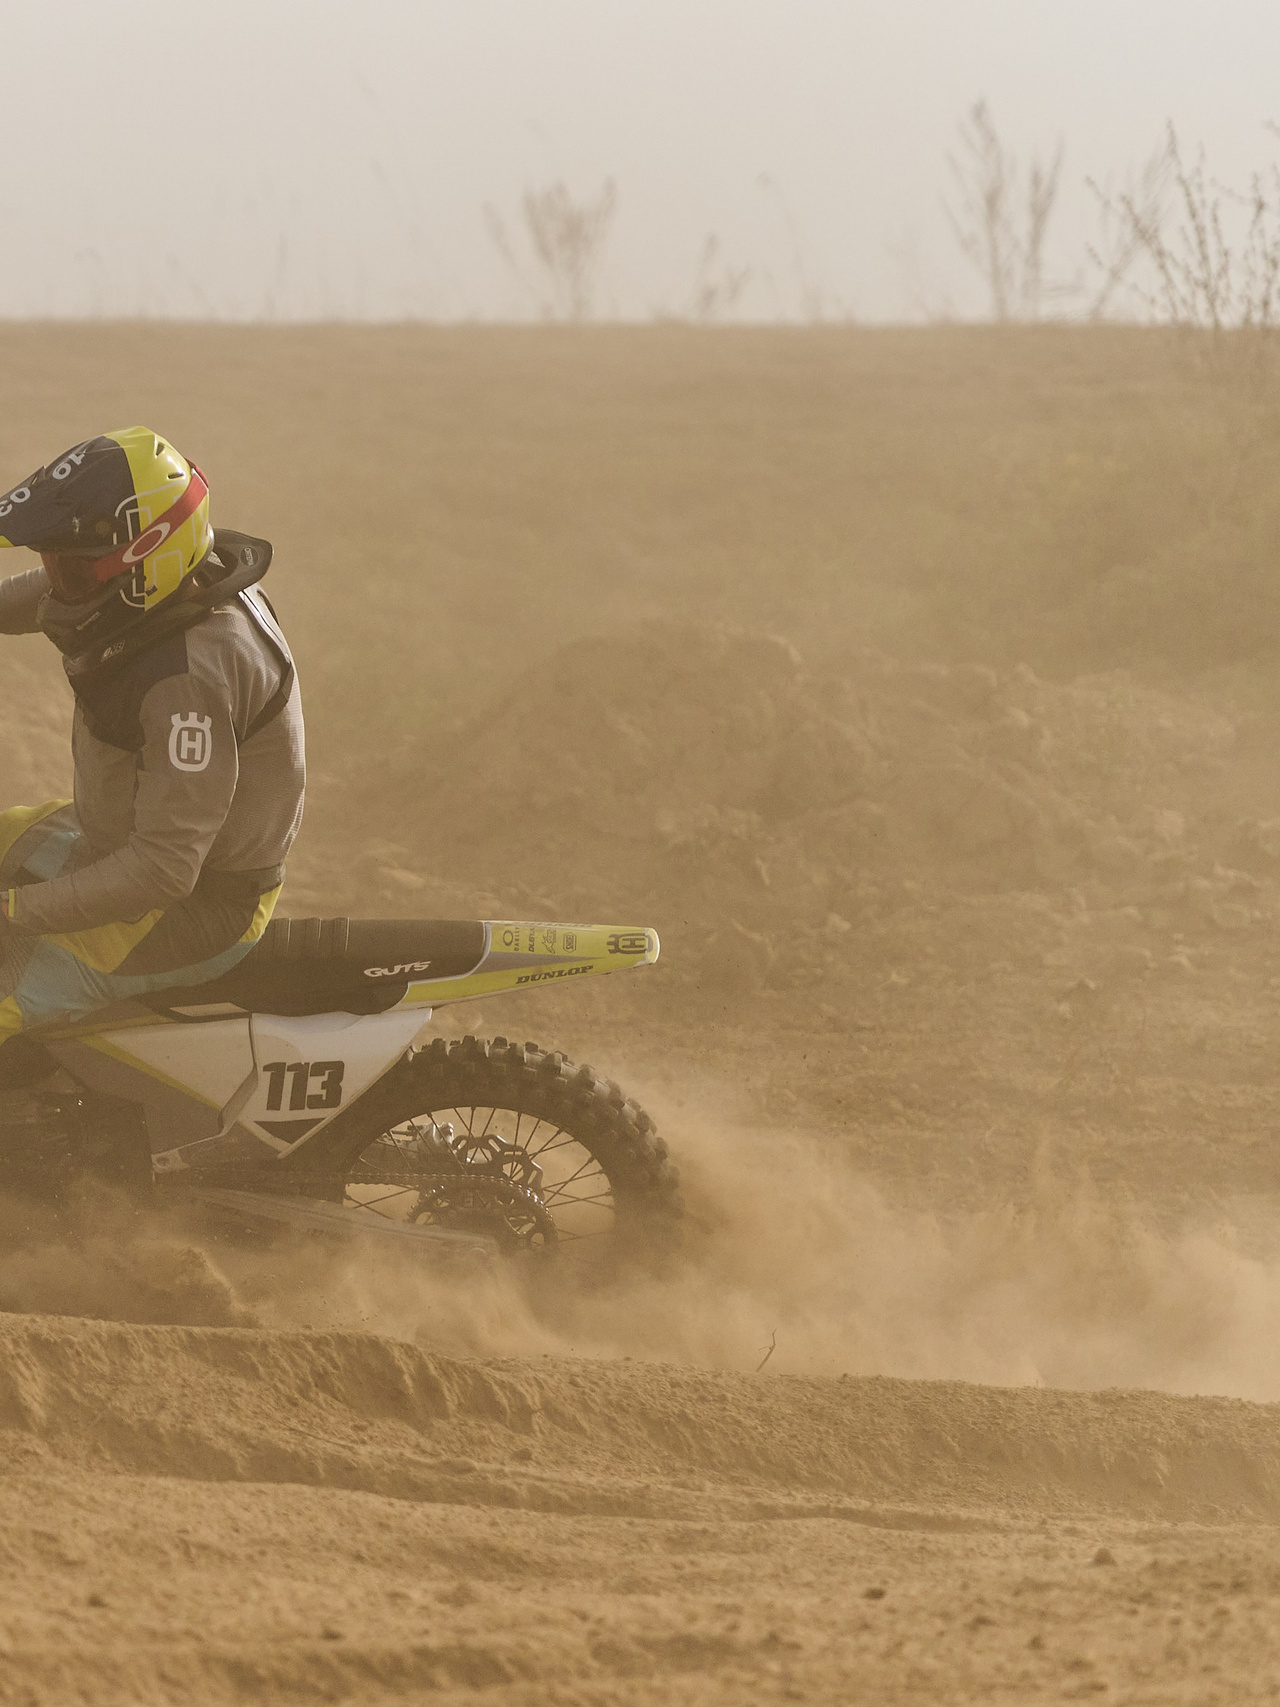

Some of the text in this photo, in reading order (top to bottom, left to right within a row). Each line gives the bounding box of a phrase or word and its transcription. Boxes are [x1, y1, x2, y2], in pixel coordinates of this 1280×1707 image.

[363, 961, 432, 978] GUTS
[515, 965, 594, 985] DUNLOP
[263, 1060, 345, 1111] 113
